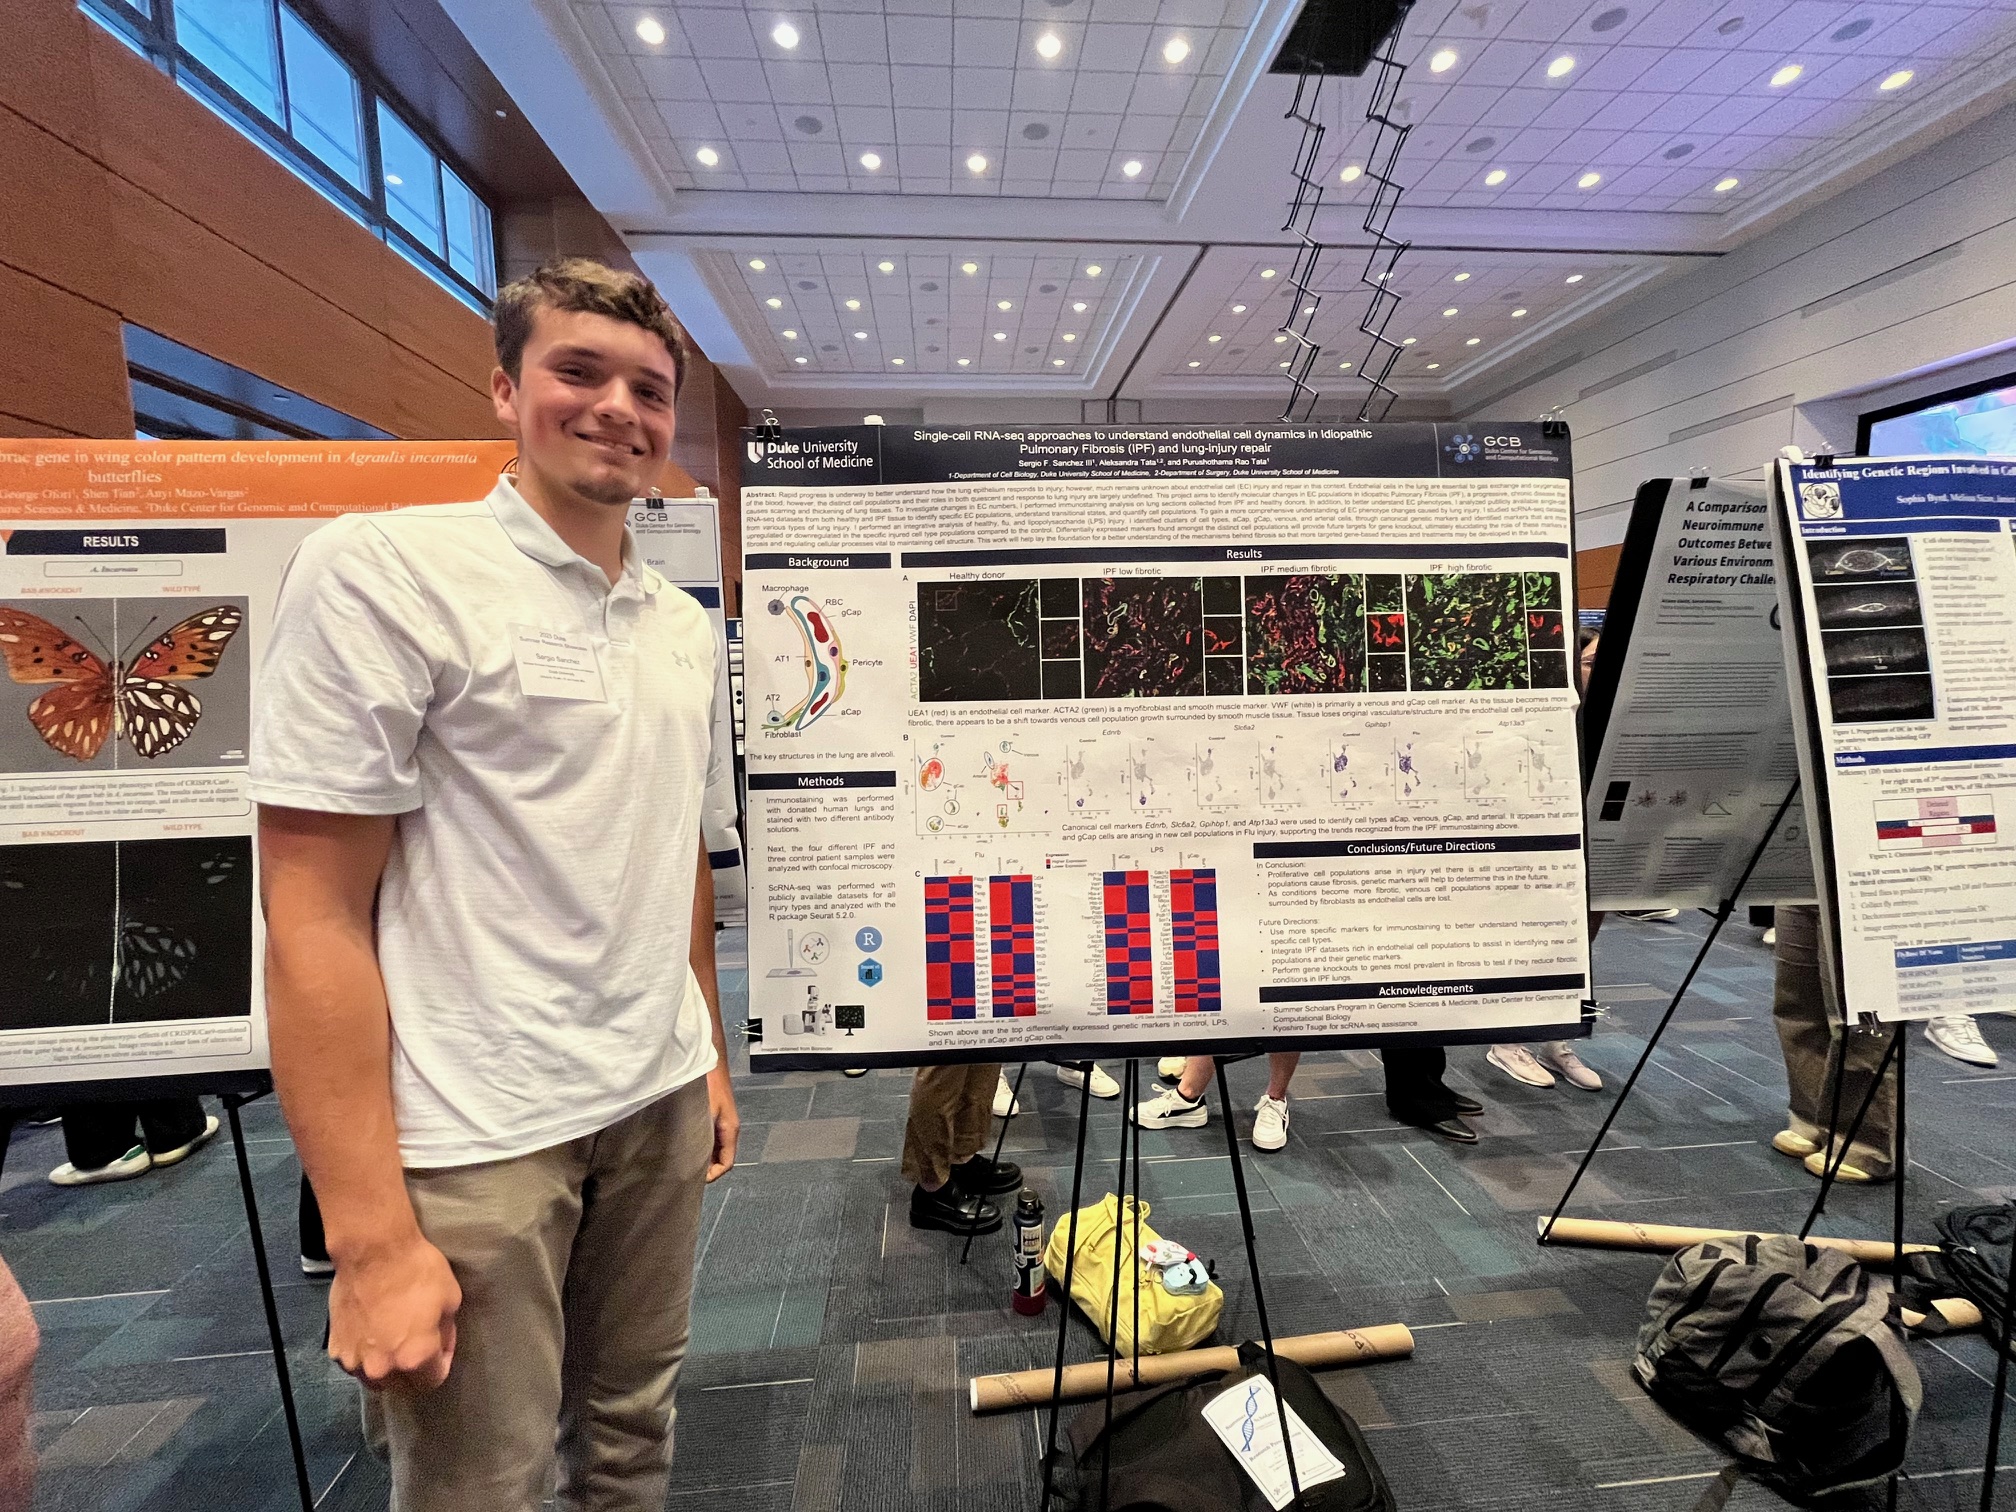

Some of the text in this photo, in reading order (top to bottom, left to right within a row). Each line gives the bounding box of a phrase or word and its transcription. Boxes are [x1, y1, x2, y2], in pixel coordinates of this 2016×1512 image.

[913, 429, 1372, 442] Single-cell RNA-seq approaches to understand endothelial cell dynamics in Idiopathic
[1483, 436, 1521, 446] GCB
[767, 439, 858, 458] Duke University
[1020, 442, 1271, 455] Pulmonary Fibrosis (IPF) and lung-injury repair
[35, 453, 70, 466] gene
[74, 450, 89, 463] in
[94, 450, 130, 466] wing
[134, 450, 173, 463] color
[176, 452, 226, 466] pattern
[231, 450, 323, 465] development
[327, 450, 341, 463] in
[344, 451, 405, 465] Agraulis
[409, 451, 478, 464] incarnata
[767, 455, 873, 468] School of Medicine
[1018, 459, 1041, 468] Sergio
[1234, 457, 1249, 465] Rao
[88, 469, 162, 483] butterflies
[1802, 464, 2000, 480] Identifying Genetic Regions Involved in
[1685, 501, 1767, 514] A Comparison
[634, 512, 668, 521] GCB
[1682, 519, 1764, 531] Neuroimmune
[1801, 526, 1846, 534] Introduction
[83, 535, 138, 547] RESULTS
[1678, 537, 1735, 548] Outcomes
[1226, 549, 1263, 559] Results
[788, 556, 849, 569] Background
[1673, 555, 1717, 566] Various
[1103, 567, 1116, 575] IPF
[1119, 567, 1133, 575] low
[1261, 564, 1337, 574] IPF medium fibrotic
[1429, 563, 1492, 573] IPF high fibrotic
[949, 571, 1005, 581] Healthy donor
[1668, 573, 1738, 587] Respiratory
[762, 584, 809, 593] Macrophage
[841, 608, 861, 617] gCap
[909, 624, 917, 644] VWF
[774, 654, 789, 662] AT1
[852, 659, 883, 667] Pericyte
[909, 646, 917, 669] UEA1
[910, 671, 918, 699] ACTA2
[765, 693, 780, 702] AT2
[765, 729, 801, 738] Fibroblast
[763, 753, 776, 761] key
[838, 751, 854, 759] lung
[798, 776, 844, 786] Methods
[856, 794, 894, 802] performed
[1347, 841, 1495, 855] Conclusions/Future Directions
[863, 932, 876, 946] R
[1378, 984, 1473, 995] Acknowledgements
